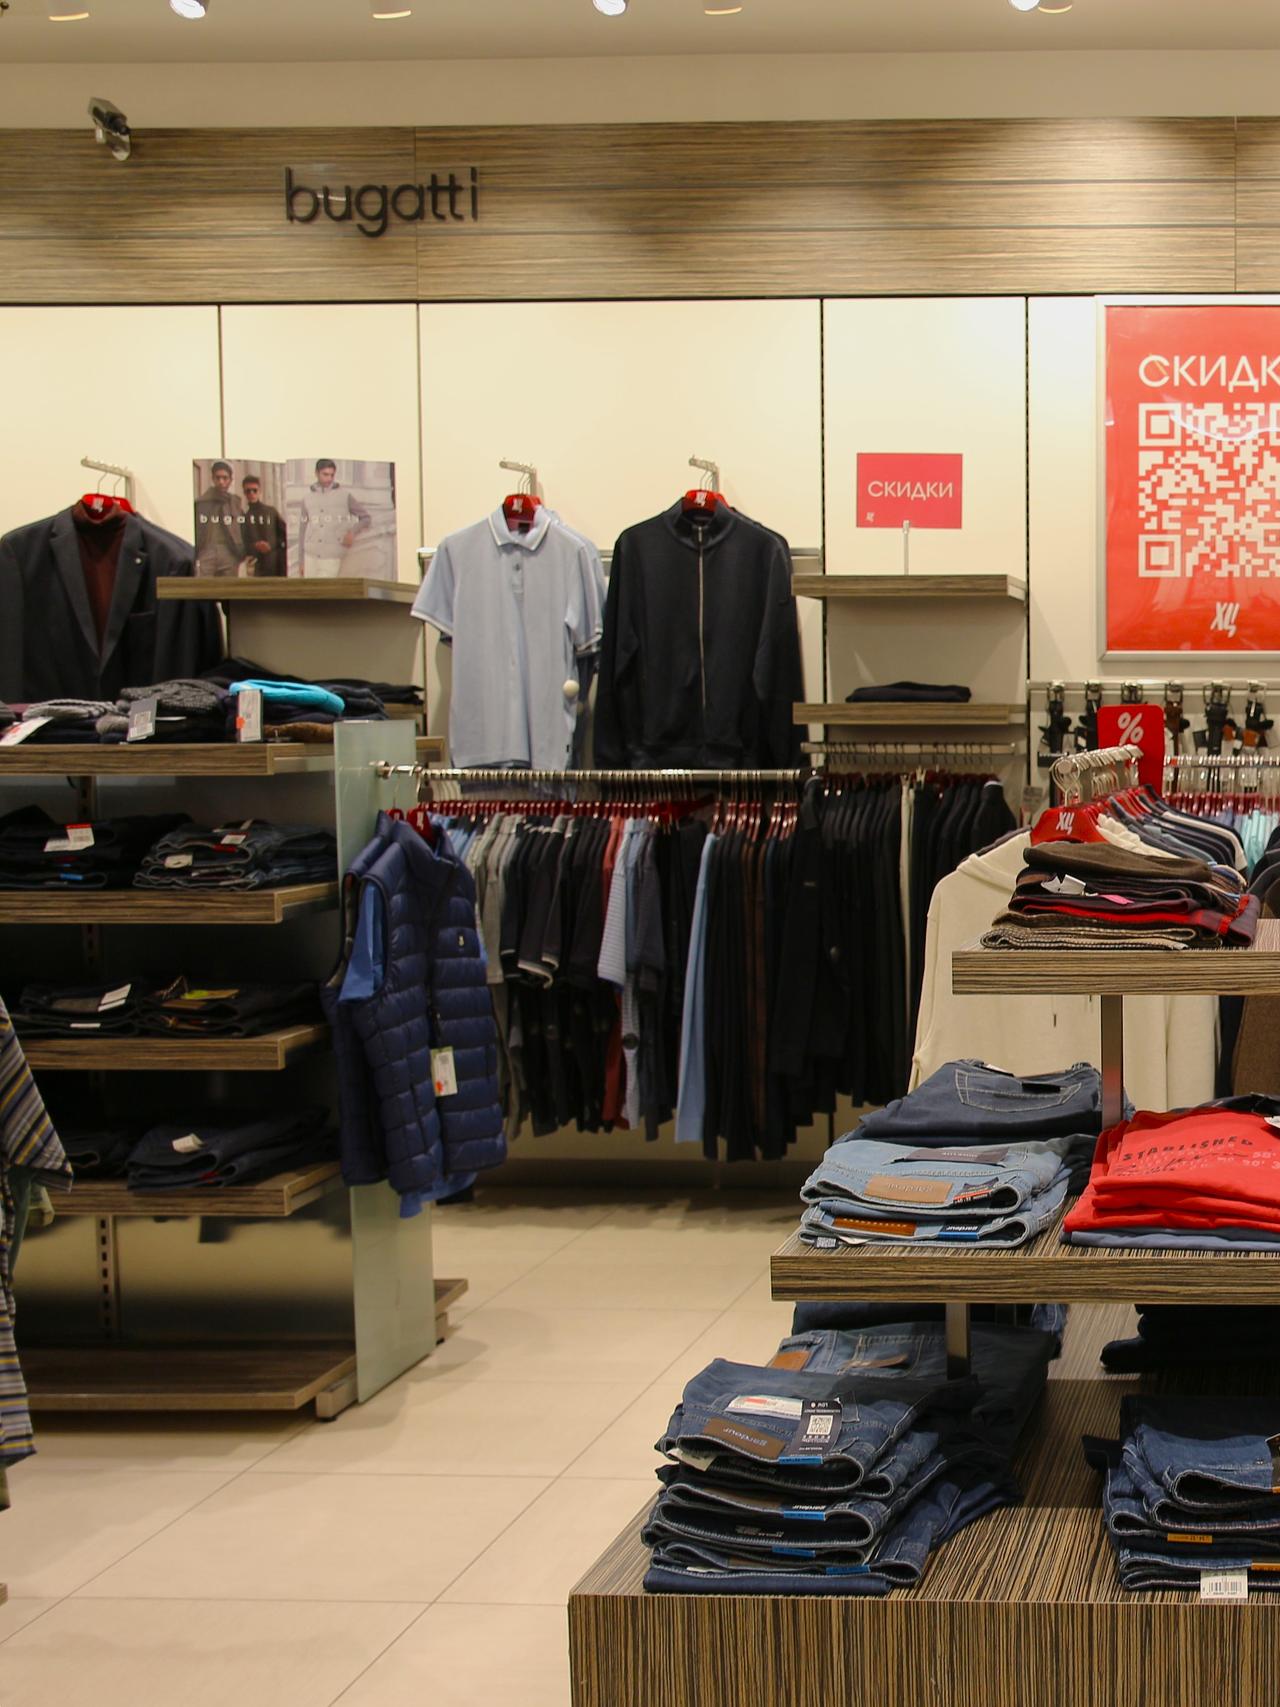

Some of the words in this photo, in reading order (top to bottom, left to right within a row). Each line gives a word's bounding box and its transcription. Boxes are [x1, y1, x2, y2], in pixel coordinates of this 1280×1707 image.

[285, 166, 480, 238] bugatti
[866, 479, 954, 501] СКИДКИ
[198, 513, 272, 526] bugatti
[721, 1426, 768, 1447] gardeur
